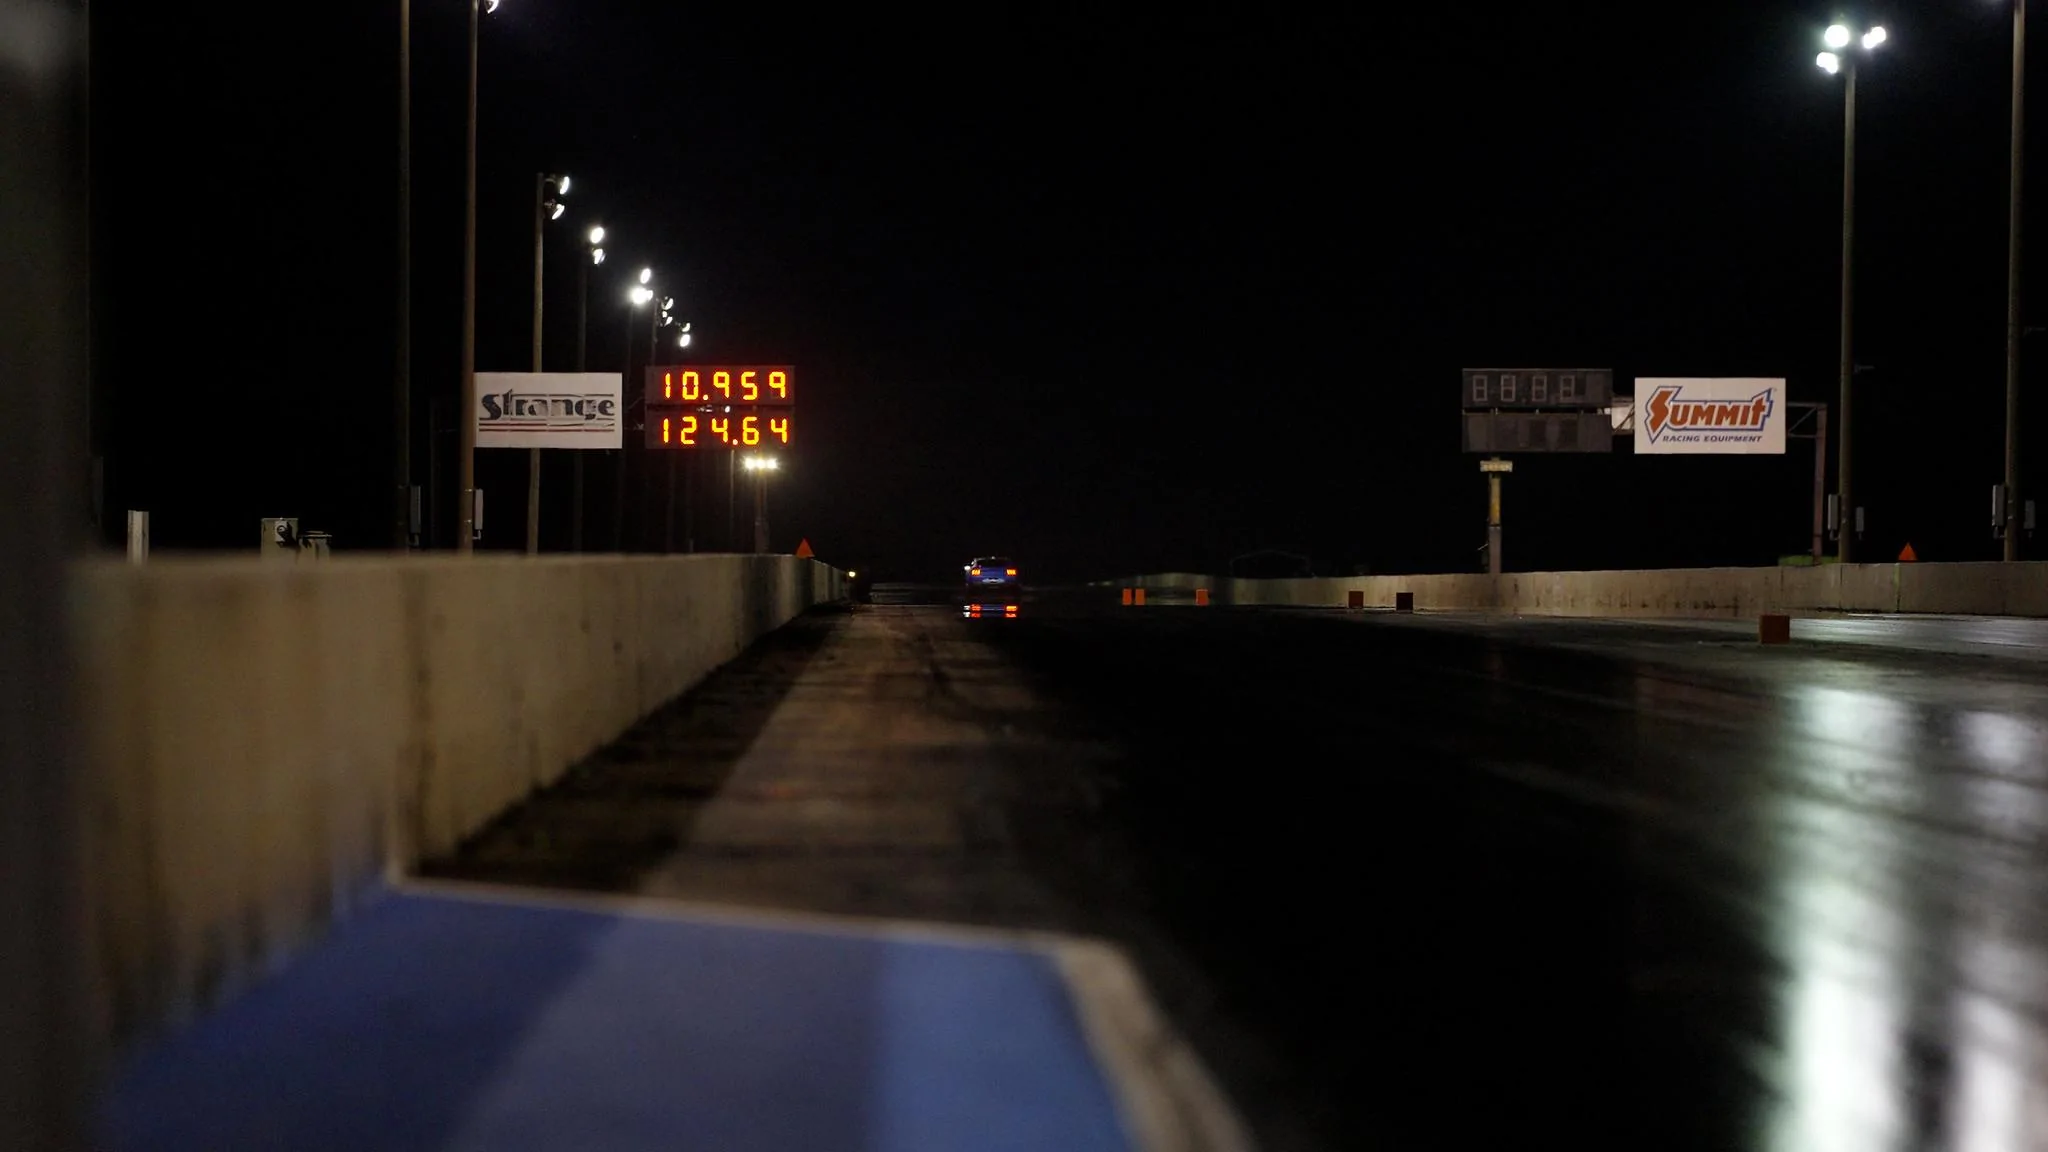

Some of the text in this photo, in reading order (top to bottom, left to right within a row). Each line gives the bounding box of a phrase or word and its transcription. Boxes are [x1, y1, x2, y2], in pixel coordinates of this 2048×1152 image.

[664, 371, 787, 401] 10.959
[480, 389, 615, 421] Strange
[663, 416, 788, 445] 124.64
[1662, 435, 1763, 443] RACING EQUIPMENT
